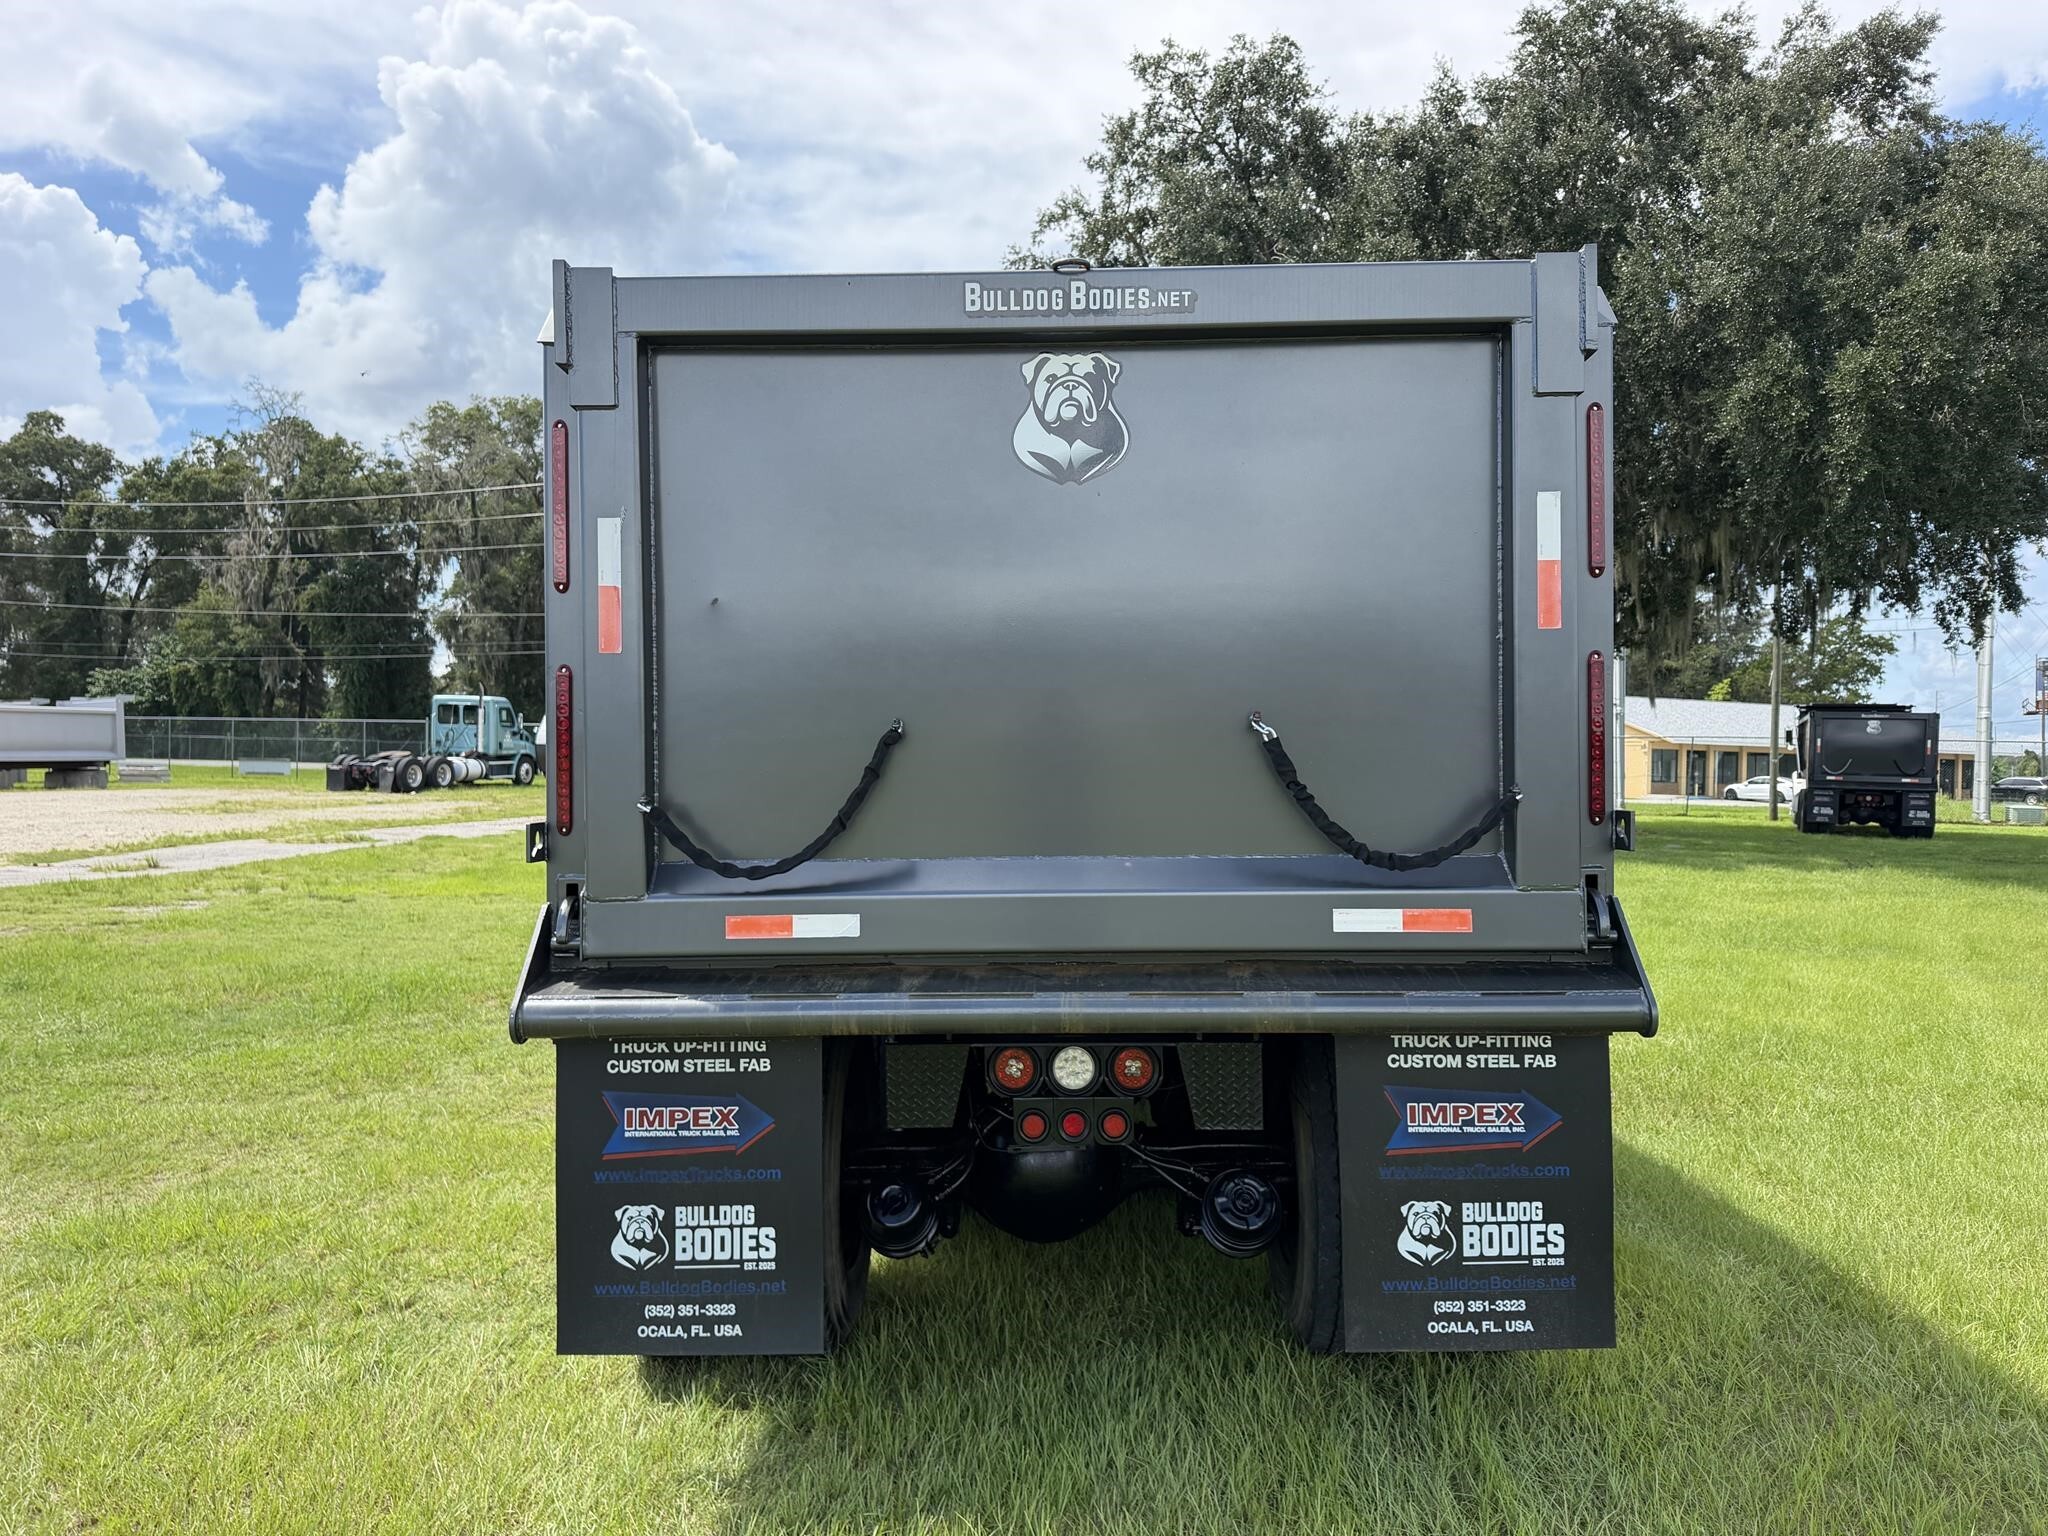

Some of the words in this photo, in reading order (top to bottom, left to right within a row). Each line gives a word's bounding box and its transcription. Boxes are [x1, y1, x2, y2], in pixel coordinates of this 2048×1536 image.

[1391, 1035, 1451, 1048] TRUCK
[1456, 1035, 1552, 1047] UP-FITTING
[607, 1059, 679, 1073] CUSTOM
[683, 1059, 735, 1072] STEEL
[740, 1058, 771, 1072] FAB
[1387, 1054, 1461, 1068] CUSTOM
[1466, 1054, 1520, 1068] STEEL
[1524, 1054, 1556, 1068] FAB
[624, 1107, 739, 1130] IMPEX
[1407, 1103, 1524, 1126] IMPEX
[675, 1205, 755, 1226] BULLDOG
[1462, 1202, 1543, 1222] BULLDOG
[675, 1227, 776, 1261] BODIES
[1462, 1224, 1565, 1257] BODIES
[744, 1262, 758, 1270] EST.
[1533, 1258, 1546, 1266] EST.
[1548, 1258, 1564, 1266] 2025
[594, 1280, 786, 1296] www.BulldogBodies.net
[1382, 1274, 1576, 1294] www.BulldogBodies.net
[645, 1305, 674, 1319] (352)
[678, 1304, 736, 1316] 351-3323
[1434, 1301, 1464, 1315] (352)
[1468, 1300, 1526, 1312] 351-3323
[638, 1325, 687, 1339] OCALA,
[691, 1325, 710, 1336] FL.
[714, 1324, 742, 1336] USA
[1427, 1321, 1479, 1335] OCALA,
[1482, 1321, 1502, 1333] FL.
[1505, 1320, 1534, 1332] USA
